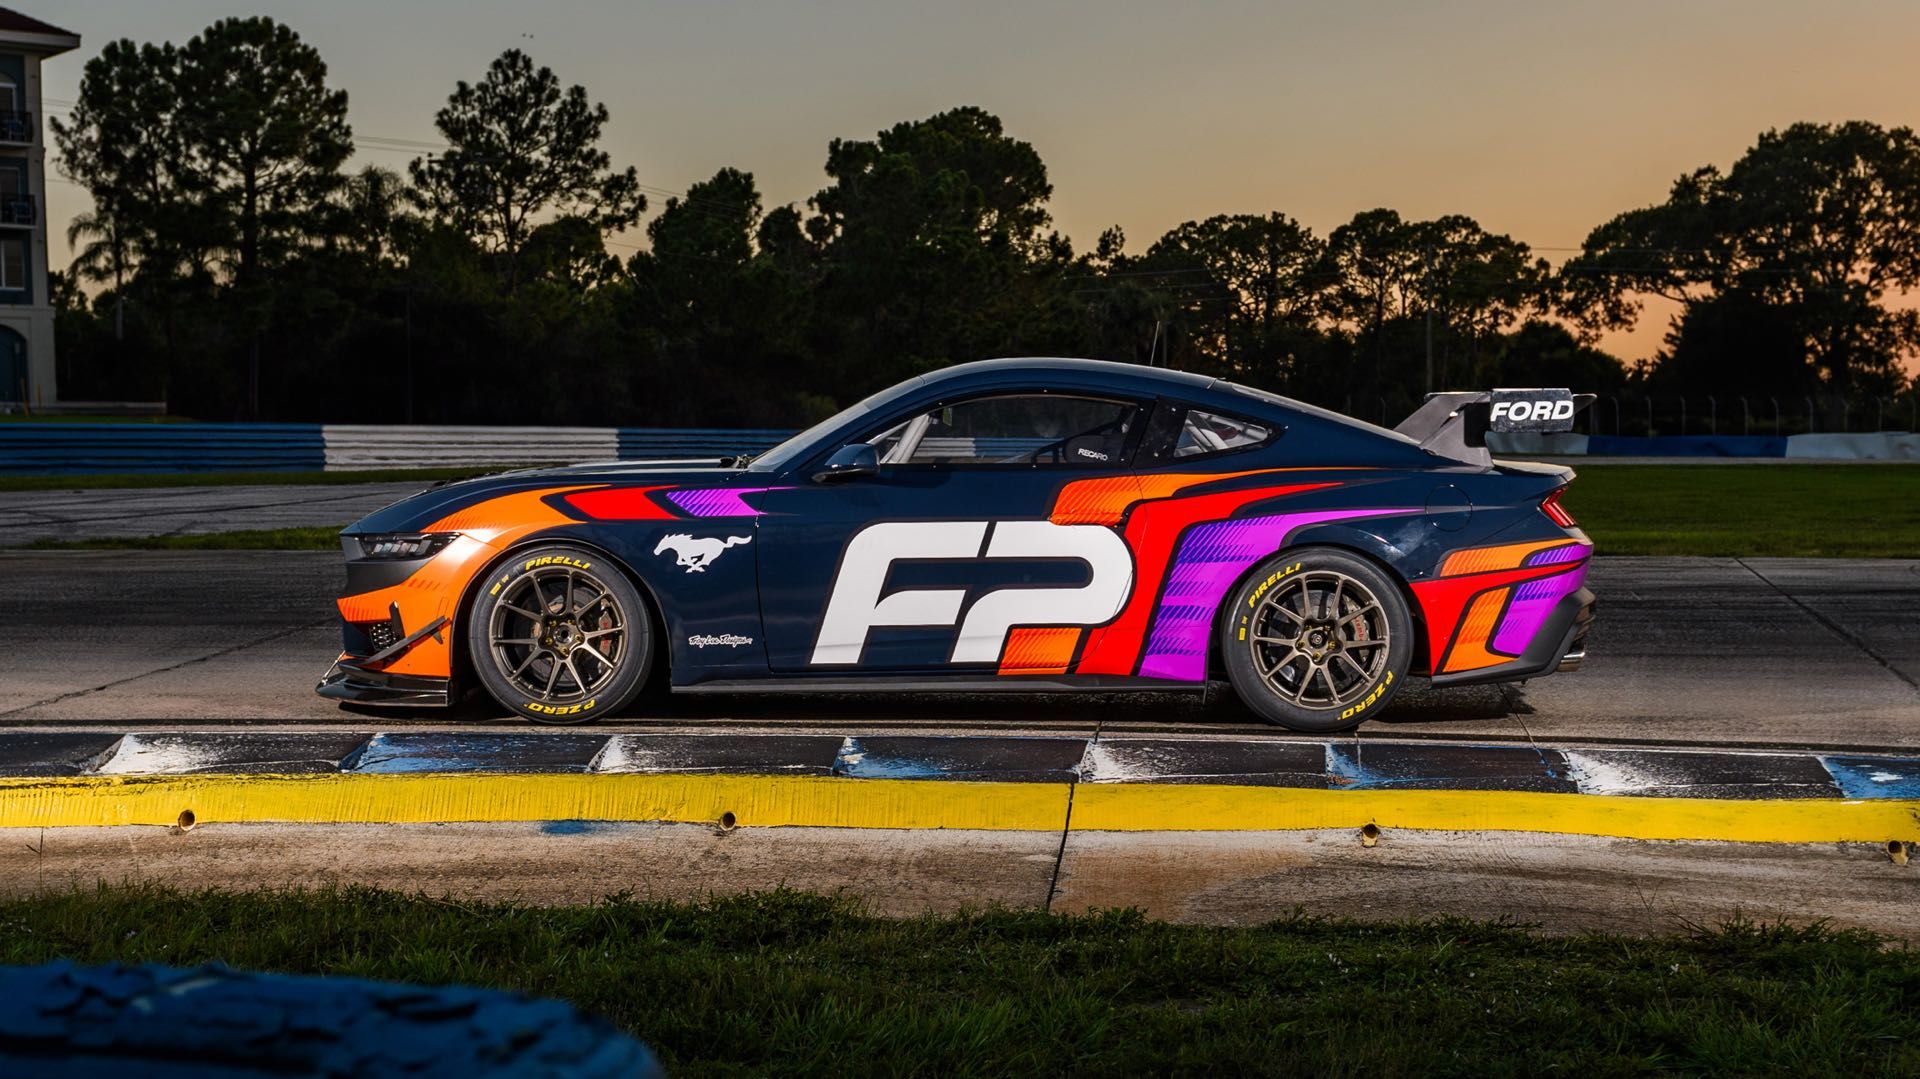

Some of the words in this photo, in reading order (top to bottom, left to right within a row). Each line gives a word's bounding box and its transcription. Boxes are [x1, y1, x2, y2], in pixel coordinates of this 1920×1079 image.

[1490, 400, 1574, 421] FORD
[1078, 448, 1108, 461] RECARO
[525, 556, 591, 571] PIRELLI
[810, 521, 1133, 664] FP
[1248, 563, 1301, 608] PIRELLI
